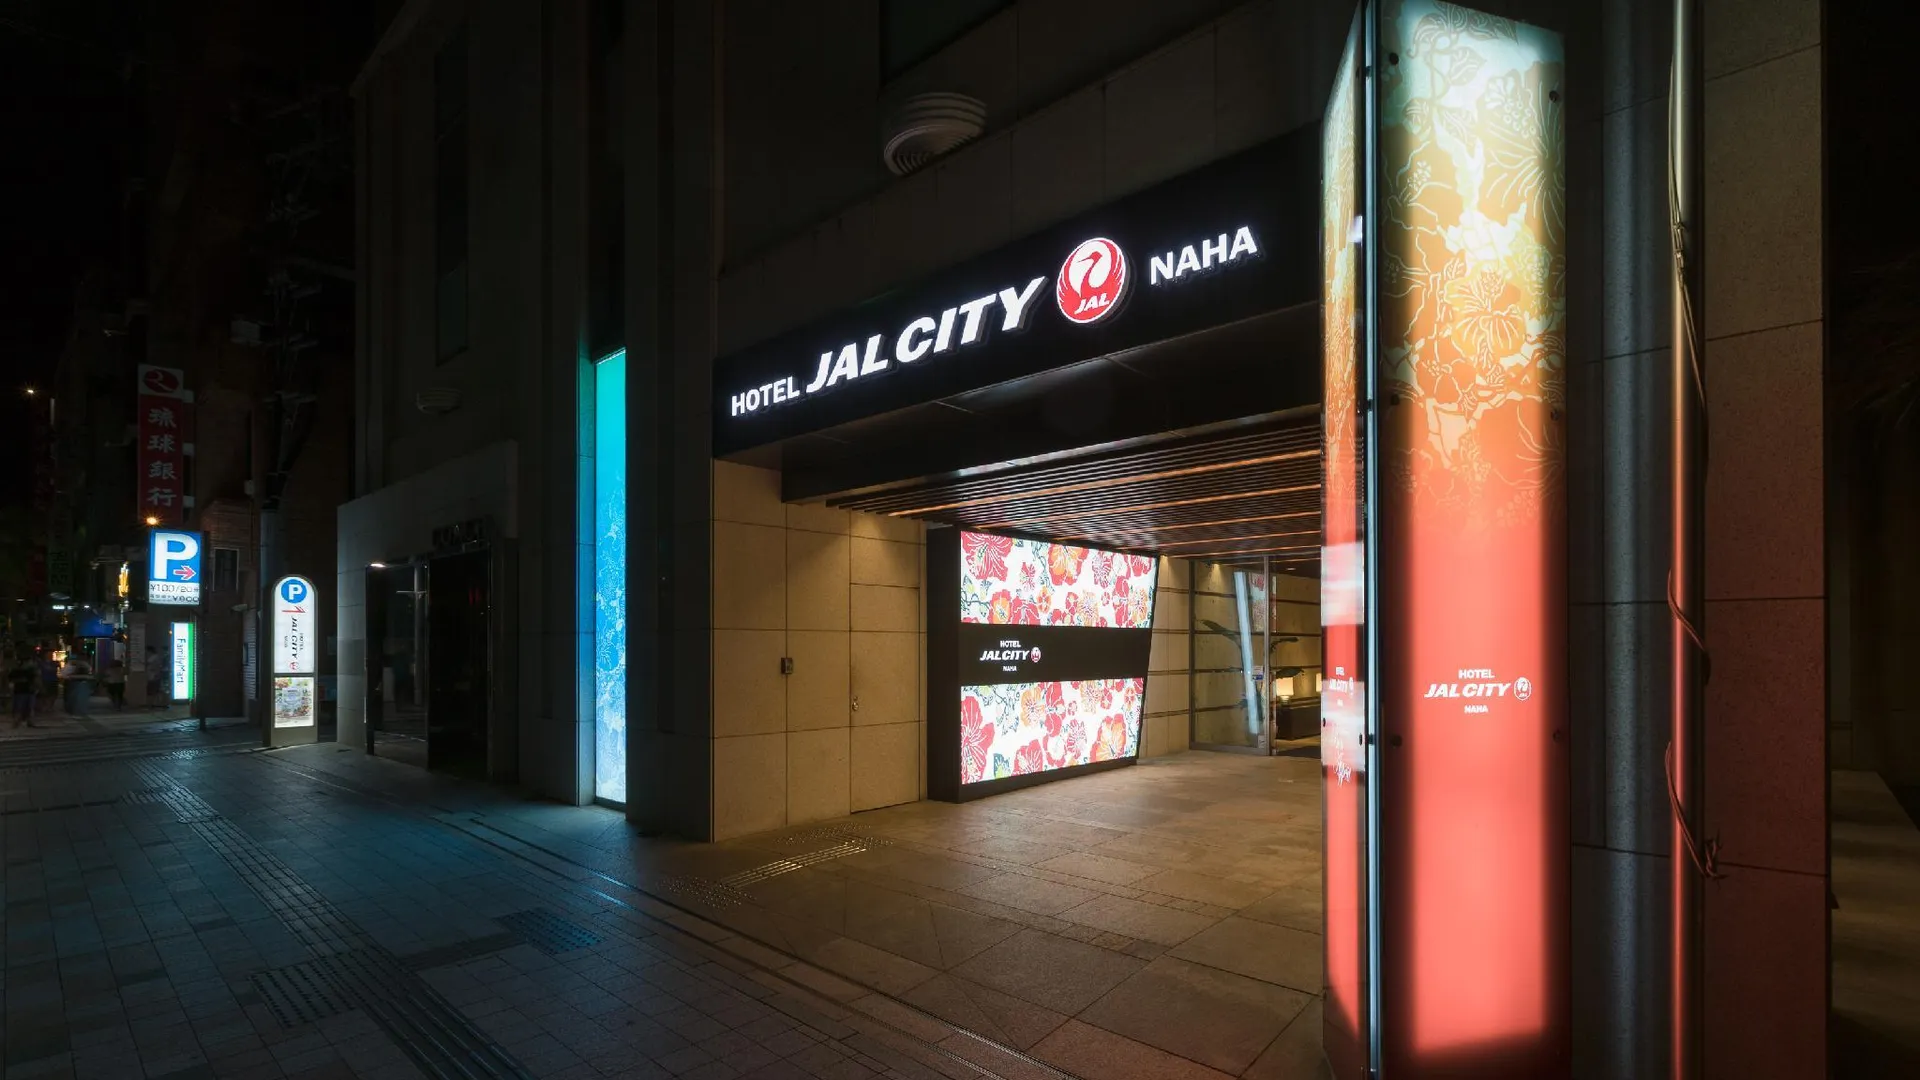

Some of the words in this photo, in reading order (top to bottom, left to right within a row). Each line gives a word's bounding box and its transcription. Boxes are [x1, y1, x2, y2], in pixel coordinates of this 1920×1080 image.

[1150, 225, 1258, 285] NAHA
[1074, 292, 1110, 315] JAL
[731, 376, 800, 417] HOTEL
[806, 333, 889, 394] JAL
[896, 275, 1046, 363] CITY
[147, 407, 177, 507] 琉球銀行
[154, 533, 198, 579] P
[288, 584, 303, 600] P
[1000, 640, 1021, 648] HOTEL
[176, 638, 186, 683] FamilyMart
[980, 650, 1002, 661] JAL
[1002, 650, 1030, 661] CITY
[1458, 669, 1495, 679] HOTEL
[1424, 683, 1460, 698] JAL
[1462, 683, 1511, 697] CITY
[1464, 705, 1489, 713] NAHA
